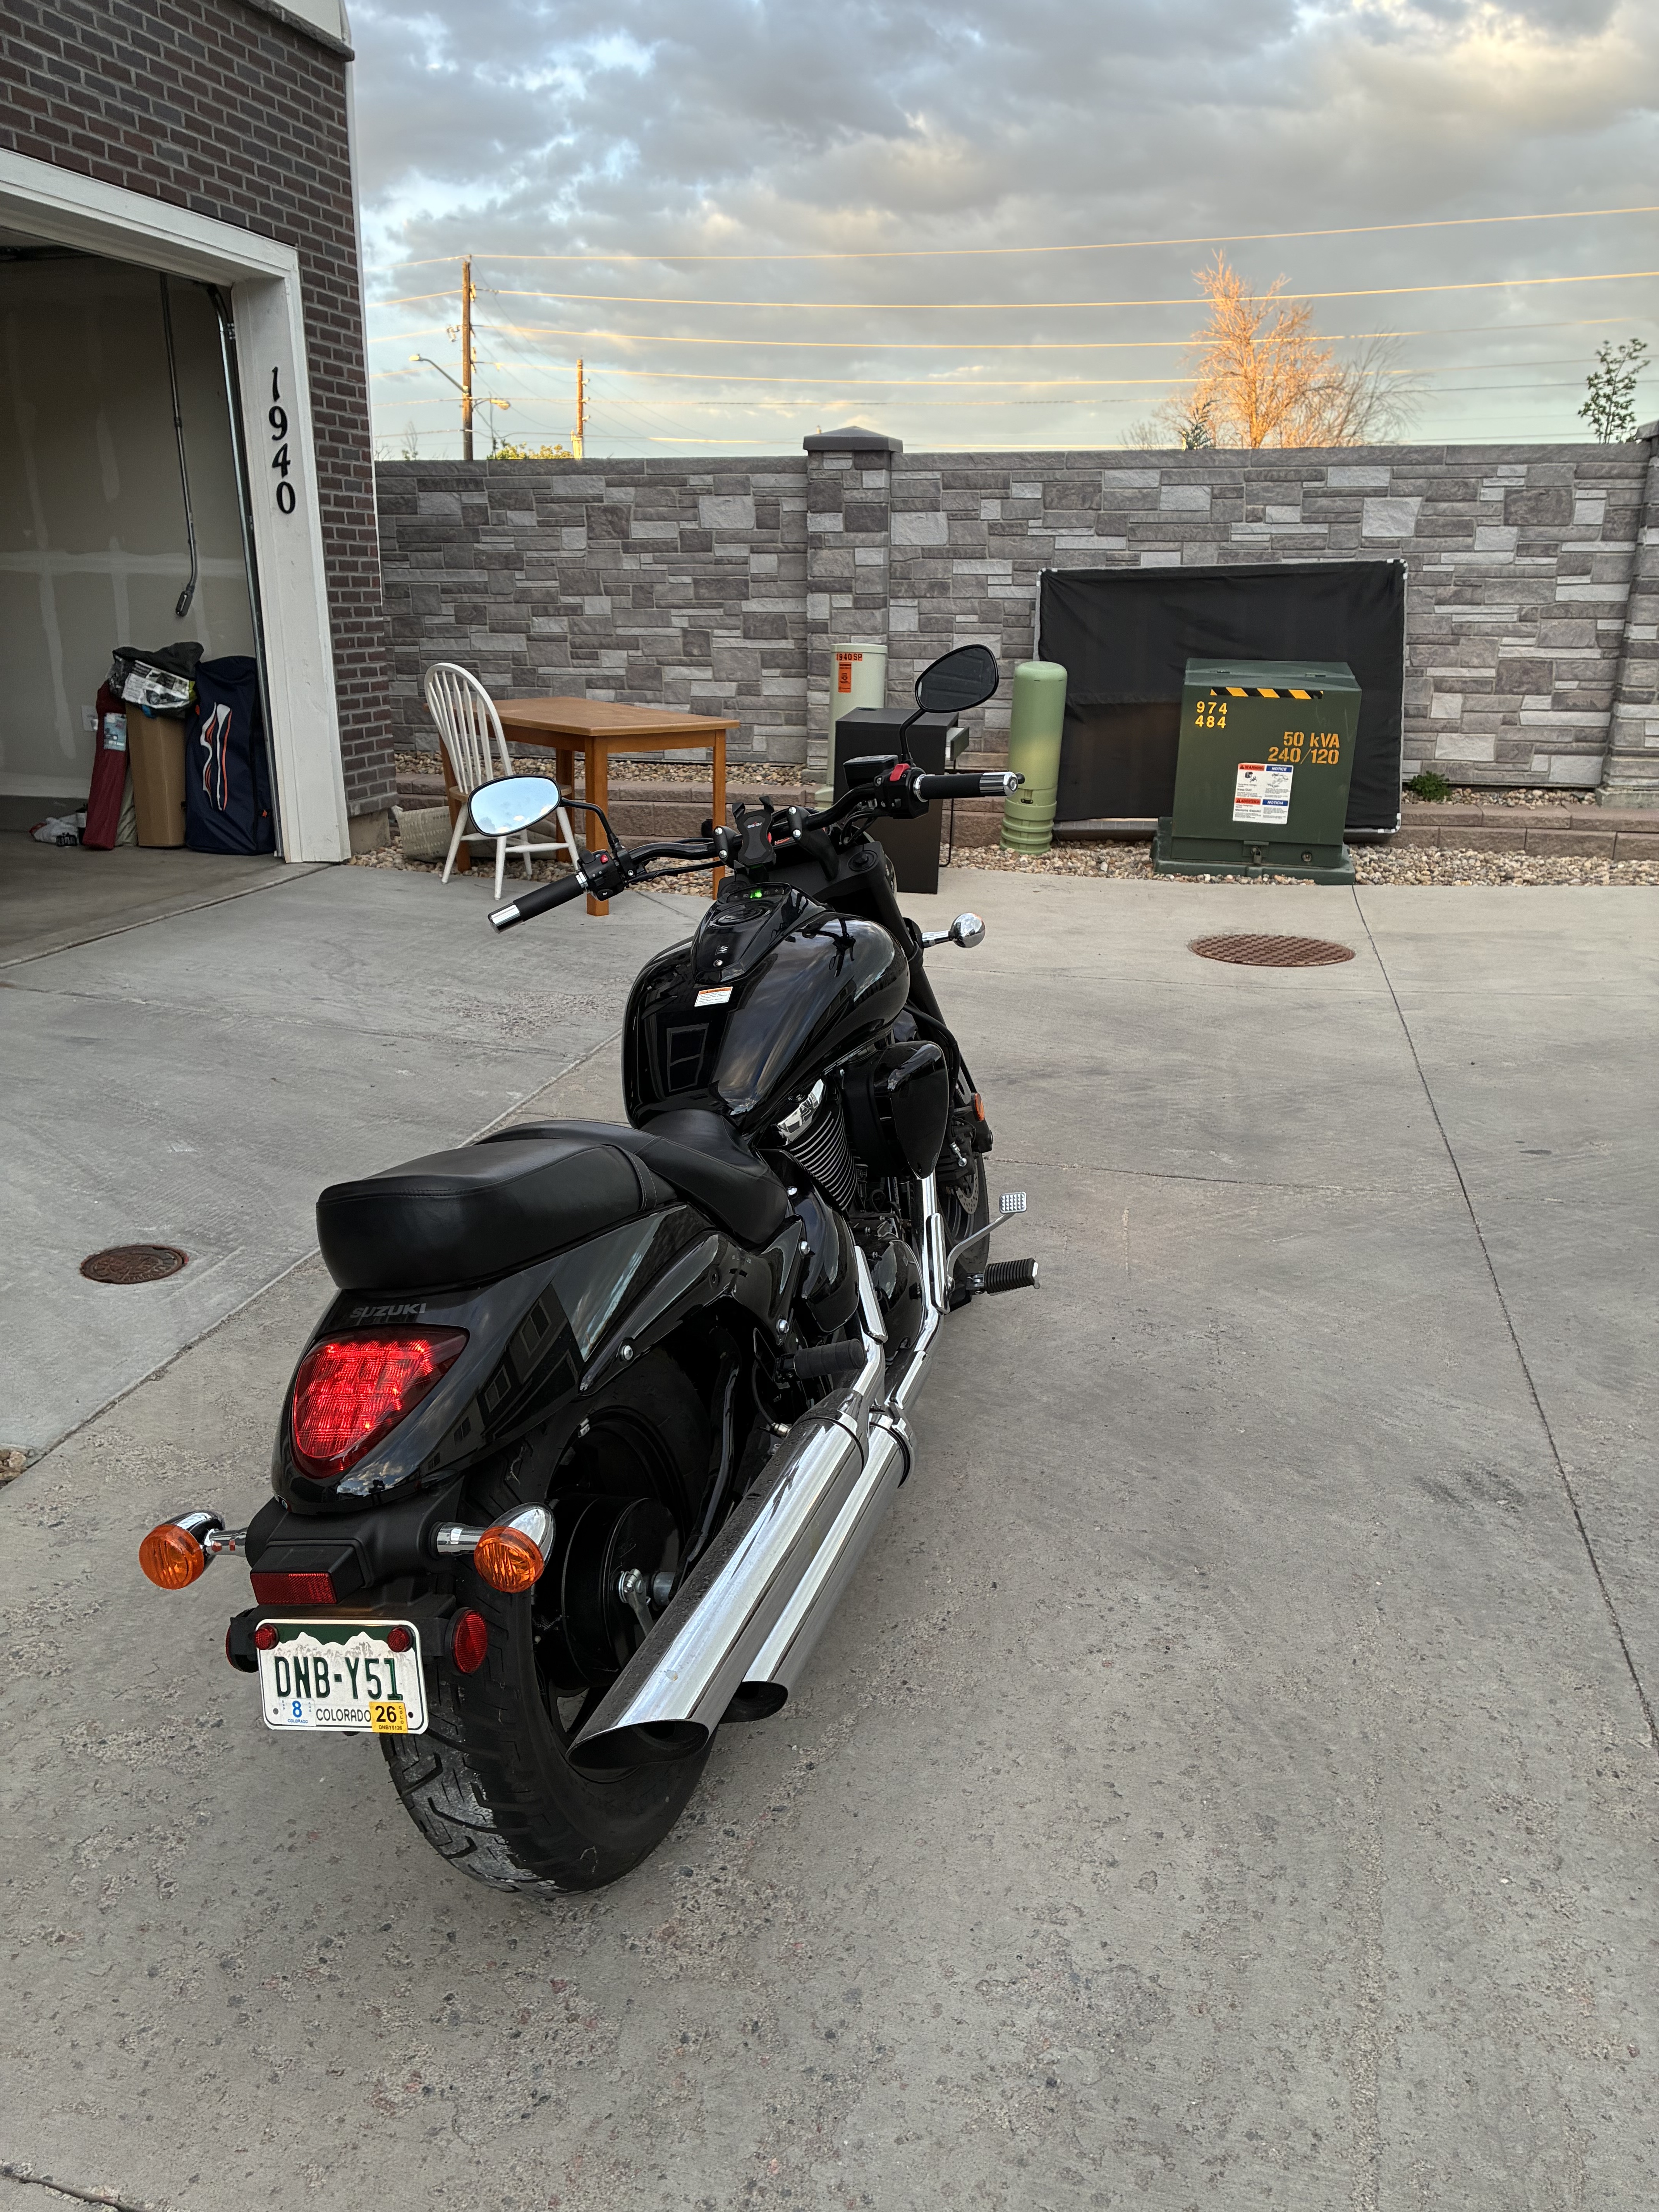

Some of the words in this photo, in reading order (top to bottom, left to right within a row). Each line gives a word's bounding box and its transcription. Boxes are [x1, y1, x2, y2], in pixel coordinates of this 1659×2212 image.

[268, 366, 295, 514] 1940
[1197, 701, 1227, 714] 974
[1195, 715, 1226, 728] 484
[1283, 732, 1304, 747] 50
[1310, 732, 1340, 748] kVA
[349, 1303, 427, 1319] SUZUKI
[275, 1656, 403, 1700] DNB-Y51
[292, 1700, 302, 1718] 8
[316, 1708, 371, 1723] COLORADO
[375, 1705, 397, 1723] 26
